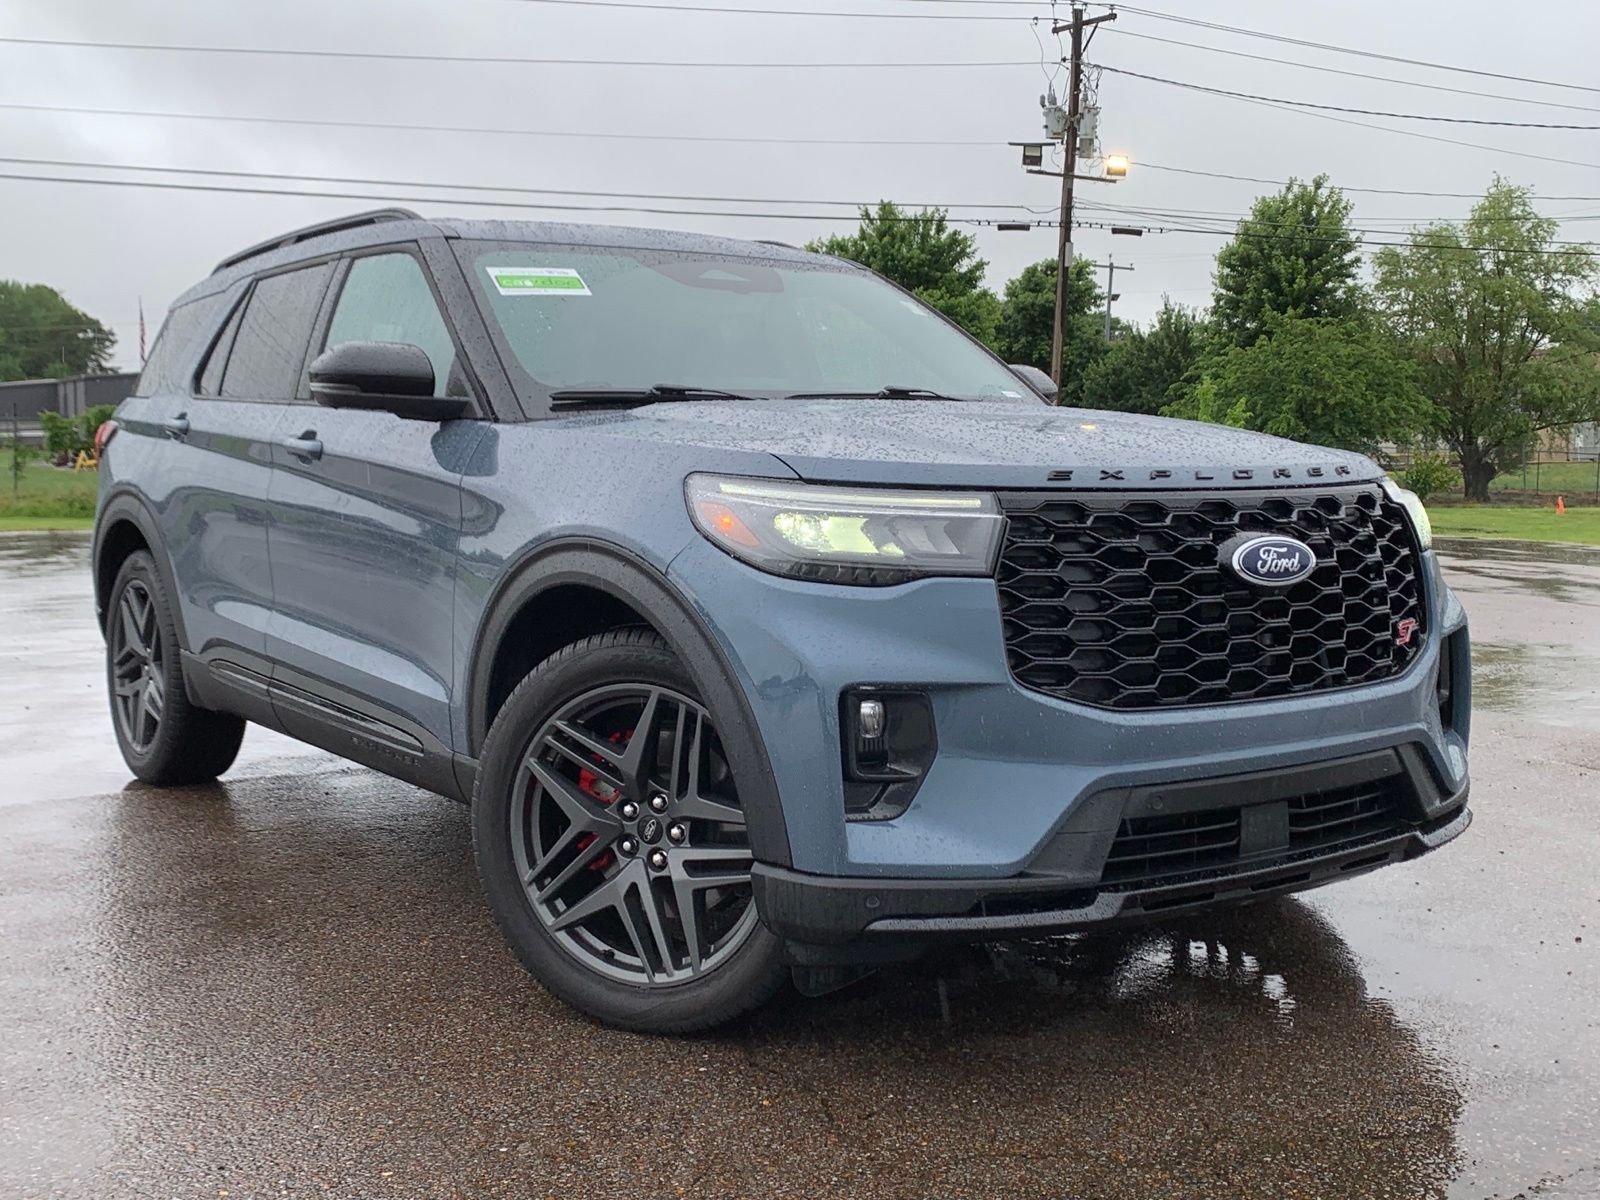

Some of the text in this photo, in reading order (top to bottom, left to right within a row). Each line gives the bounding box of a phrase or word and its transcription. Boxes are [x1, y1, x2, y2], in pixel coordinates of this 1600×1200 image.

[1046, 465, 1351, 482] EXPLORER
[1256, 546, 1301, 574] Ford
[1396, 617, 1416, 645] ST
